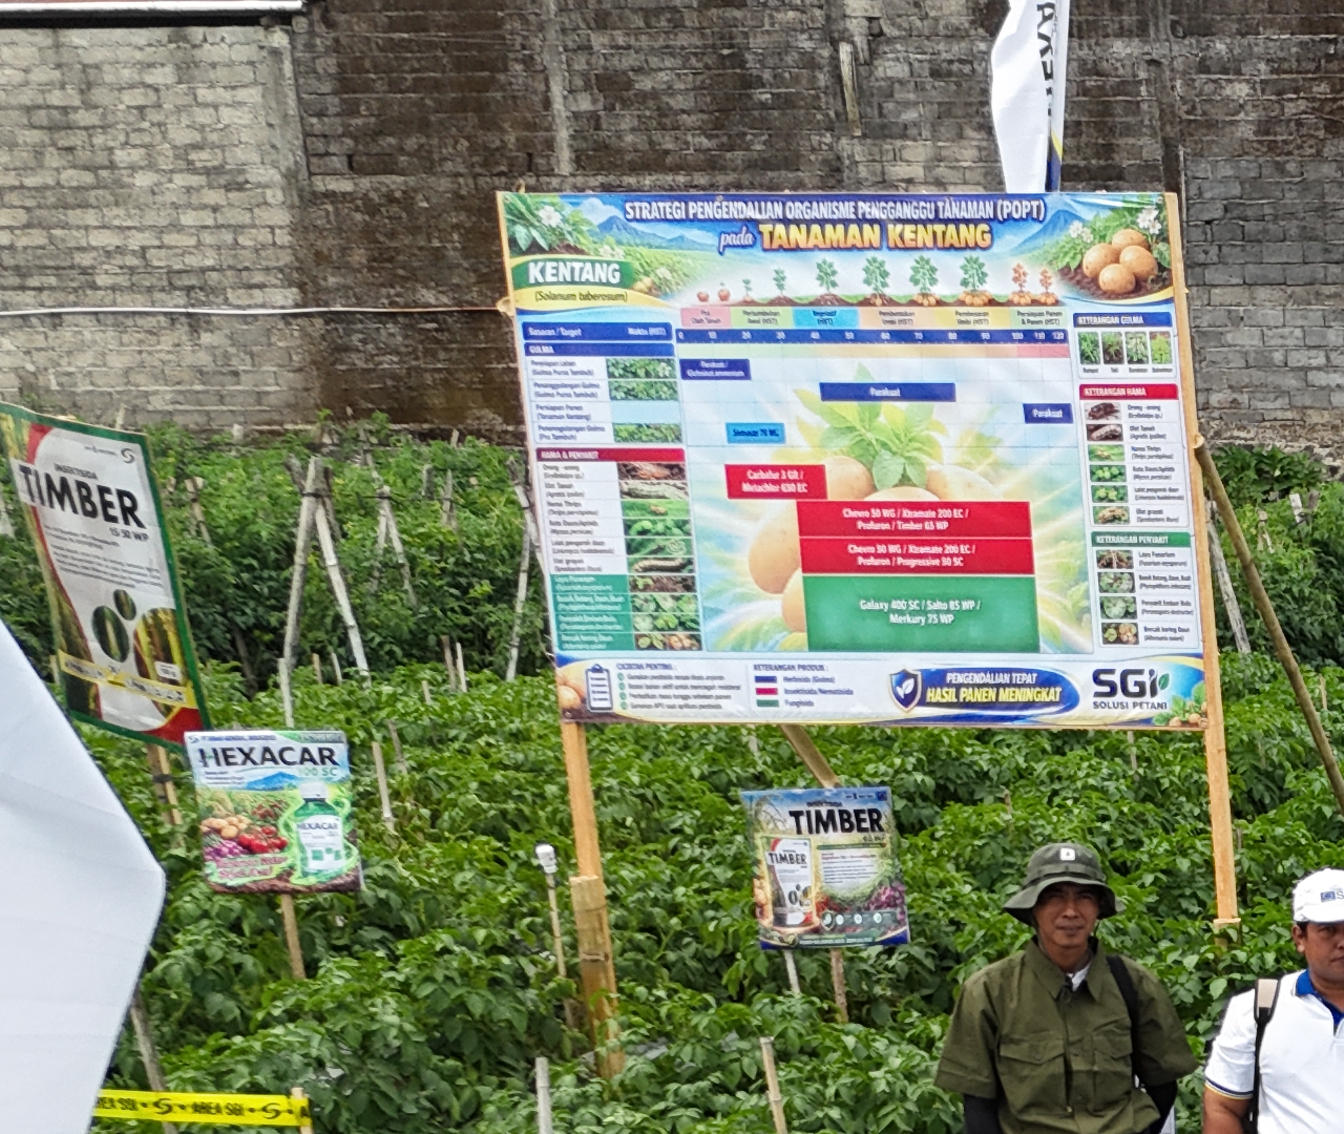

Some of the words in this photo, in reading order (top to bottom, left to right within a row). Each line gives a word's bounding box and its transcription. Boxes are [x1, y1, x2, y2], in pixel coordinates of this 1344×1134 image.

[625, 201, 685, 220] STRATEGI
[688, 201, 783, 220] PENGENDALIAN
[785, 201, 856, 220] ORGANISME
[857, 201, 935, 220] PENGGANGGU
[936, 200, 995, 220] TANAMAN
[997, 200, 1045, 222] (POPT)
[719, 226, 754, 254] pada
[758, 224, 881, 249] TANAMAN
[887, 224, 992, 248] KENTANG
[529, 261, 620, 284] KENTANG
[535, 291, 576, 302] (Solanum
[578, 291, 628, 302] tuberosum)
[19, 464, 147, 529] TIMBER
[860, 600, 889, 612] Galaxy
[908, 600, 921, 611] SC
[927, 600, 948, 611] Salto
[962, 600, 976, 611] WP
[890, 613, 925, 626] Merkury
[940, 614, 954, 624] WP
[946, 672, 1009, 684] PENGENDALIAN
[1012, 673, 1038, 684] TEPAT
[1093, 668, 1159, 698] SGI
[926, 688, 957, 703] HASIL
[960, 688, 997, 702] PANEN
[999, 687, 1062, 702] MENINGKAT
[1132, 702, 1167, 710] PETANI
[199, 746, 340, 767] HEXACAR
[322, 767, 338, 776] SC
[789, 808, 885, 835] TIMBER
[768, 853, 806, 865] TIMBER
[192, 1101, 222, 1115] AREA
